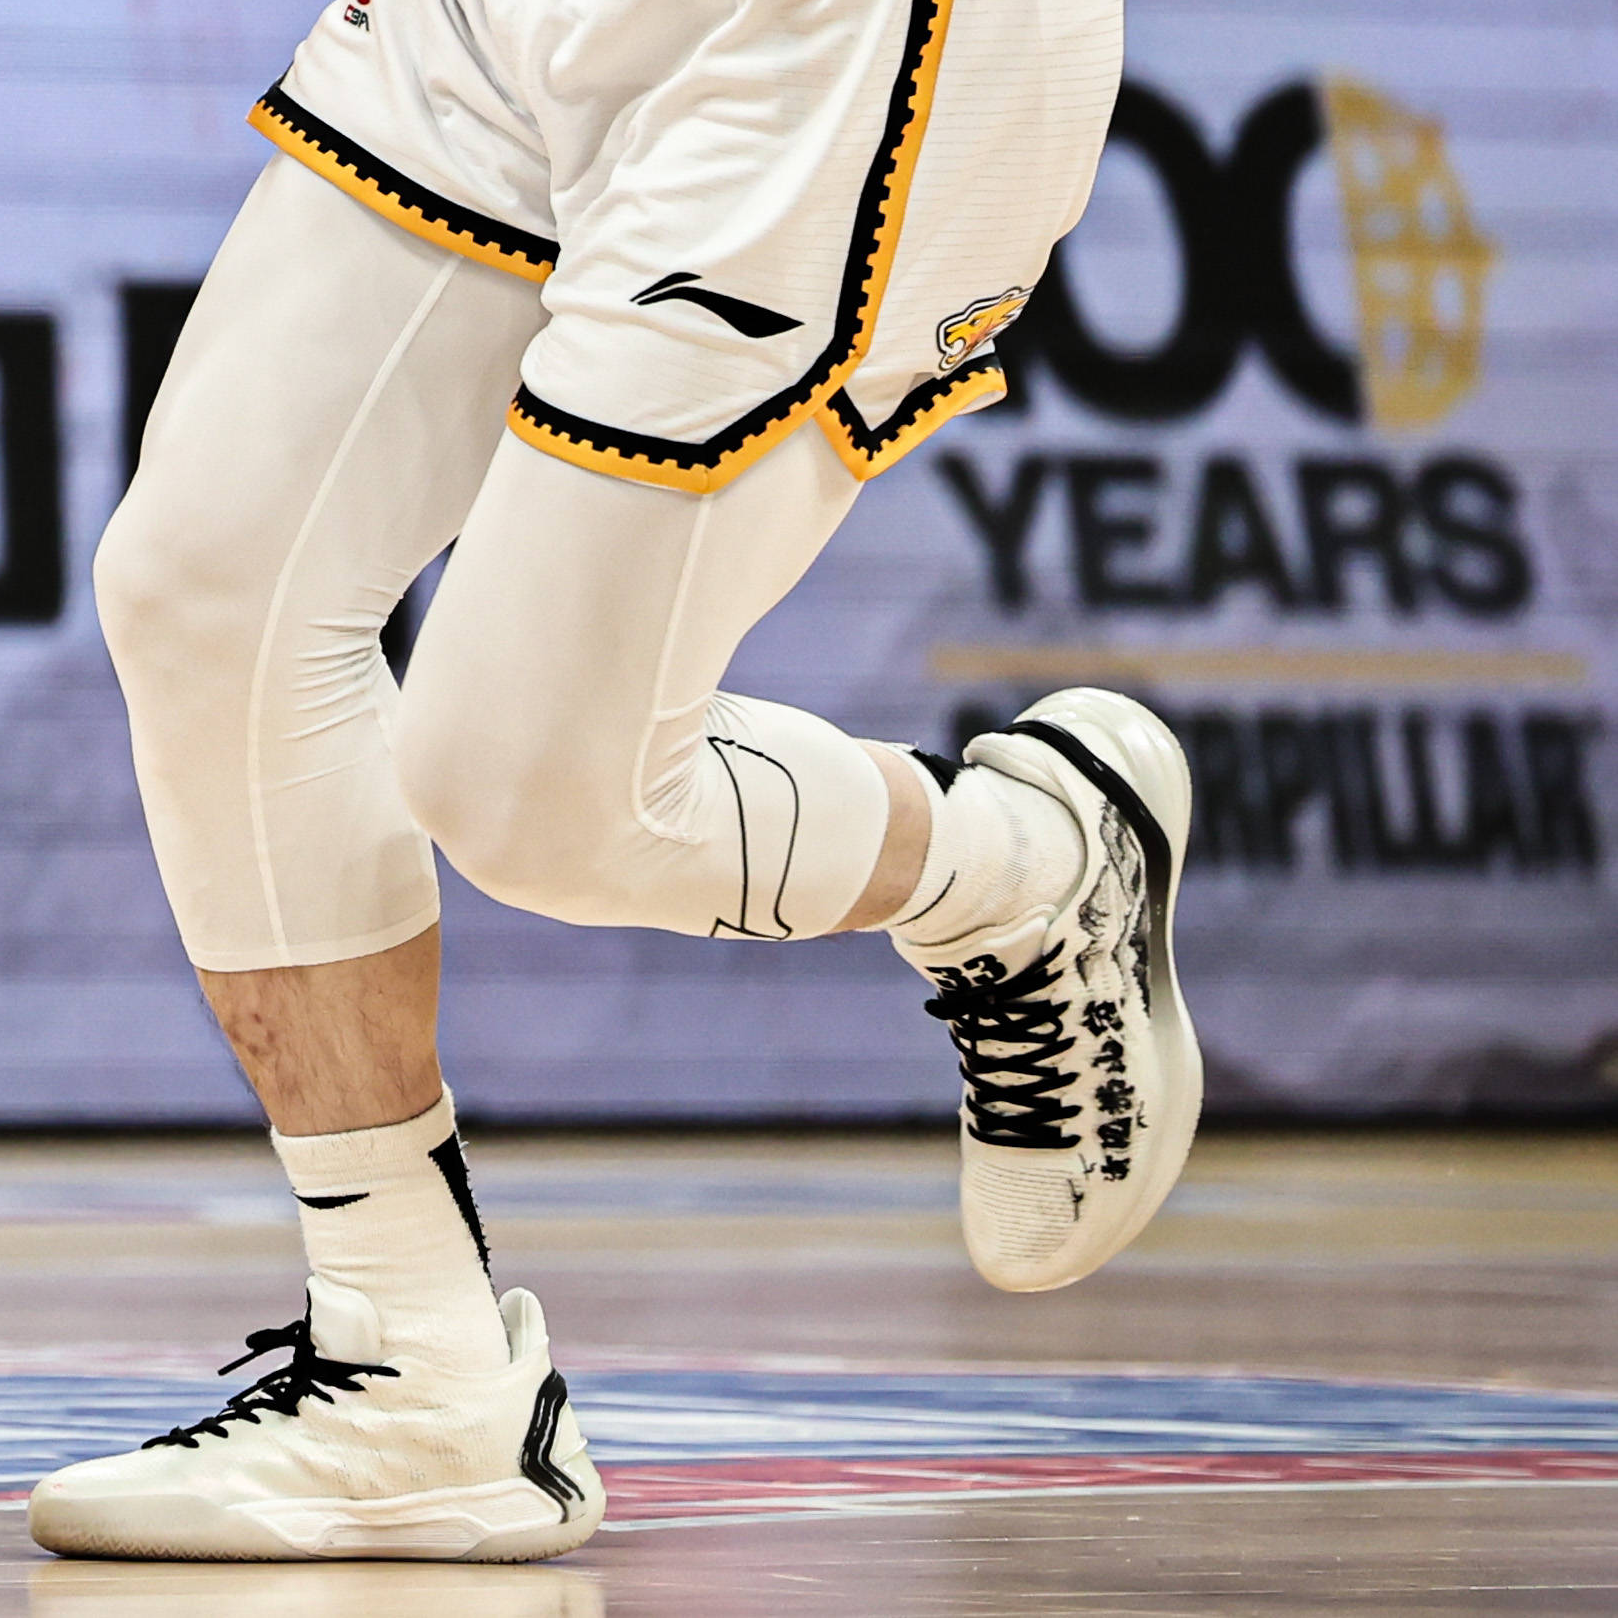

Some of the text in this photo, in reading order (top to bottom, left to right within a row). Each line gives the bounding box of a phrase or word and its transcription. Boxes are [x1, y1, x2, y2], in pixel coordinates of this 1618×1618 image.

[344, 4, 370, 32] CBA
[964, 74, 1500, 432] 00
[936, 450, 1536, 616] YEARS
[954, 700, 1602, 870] RPILLAR
